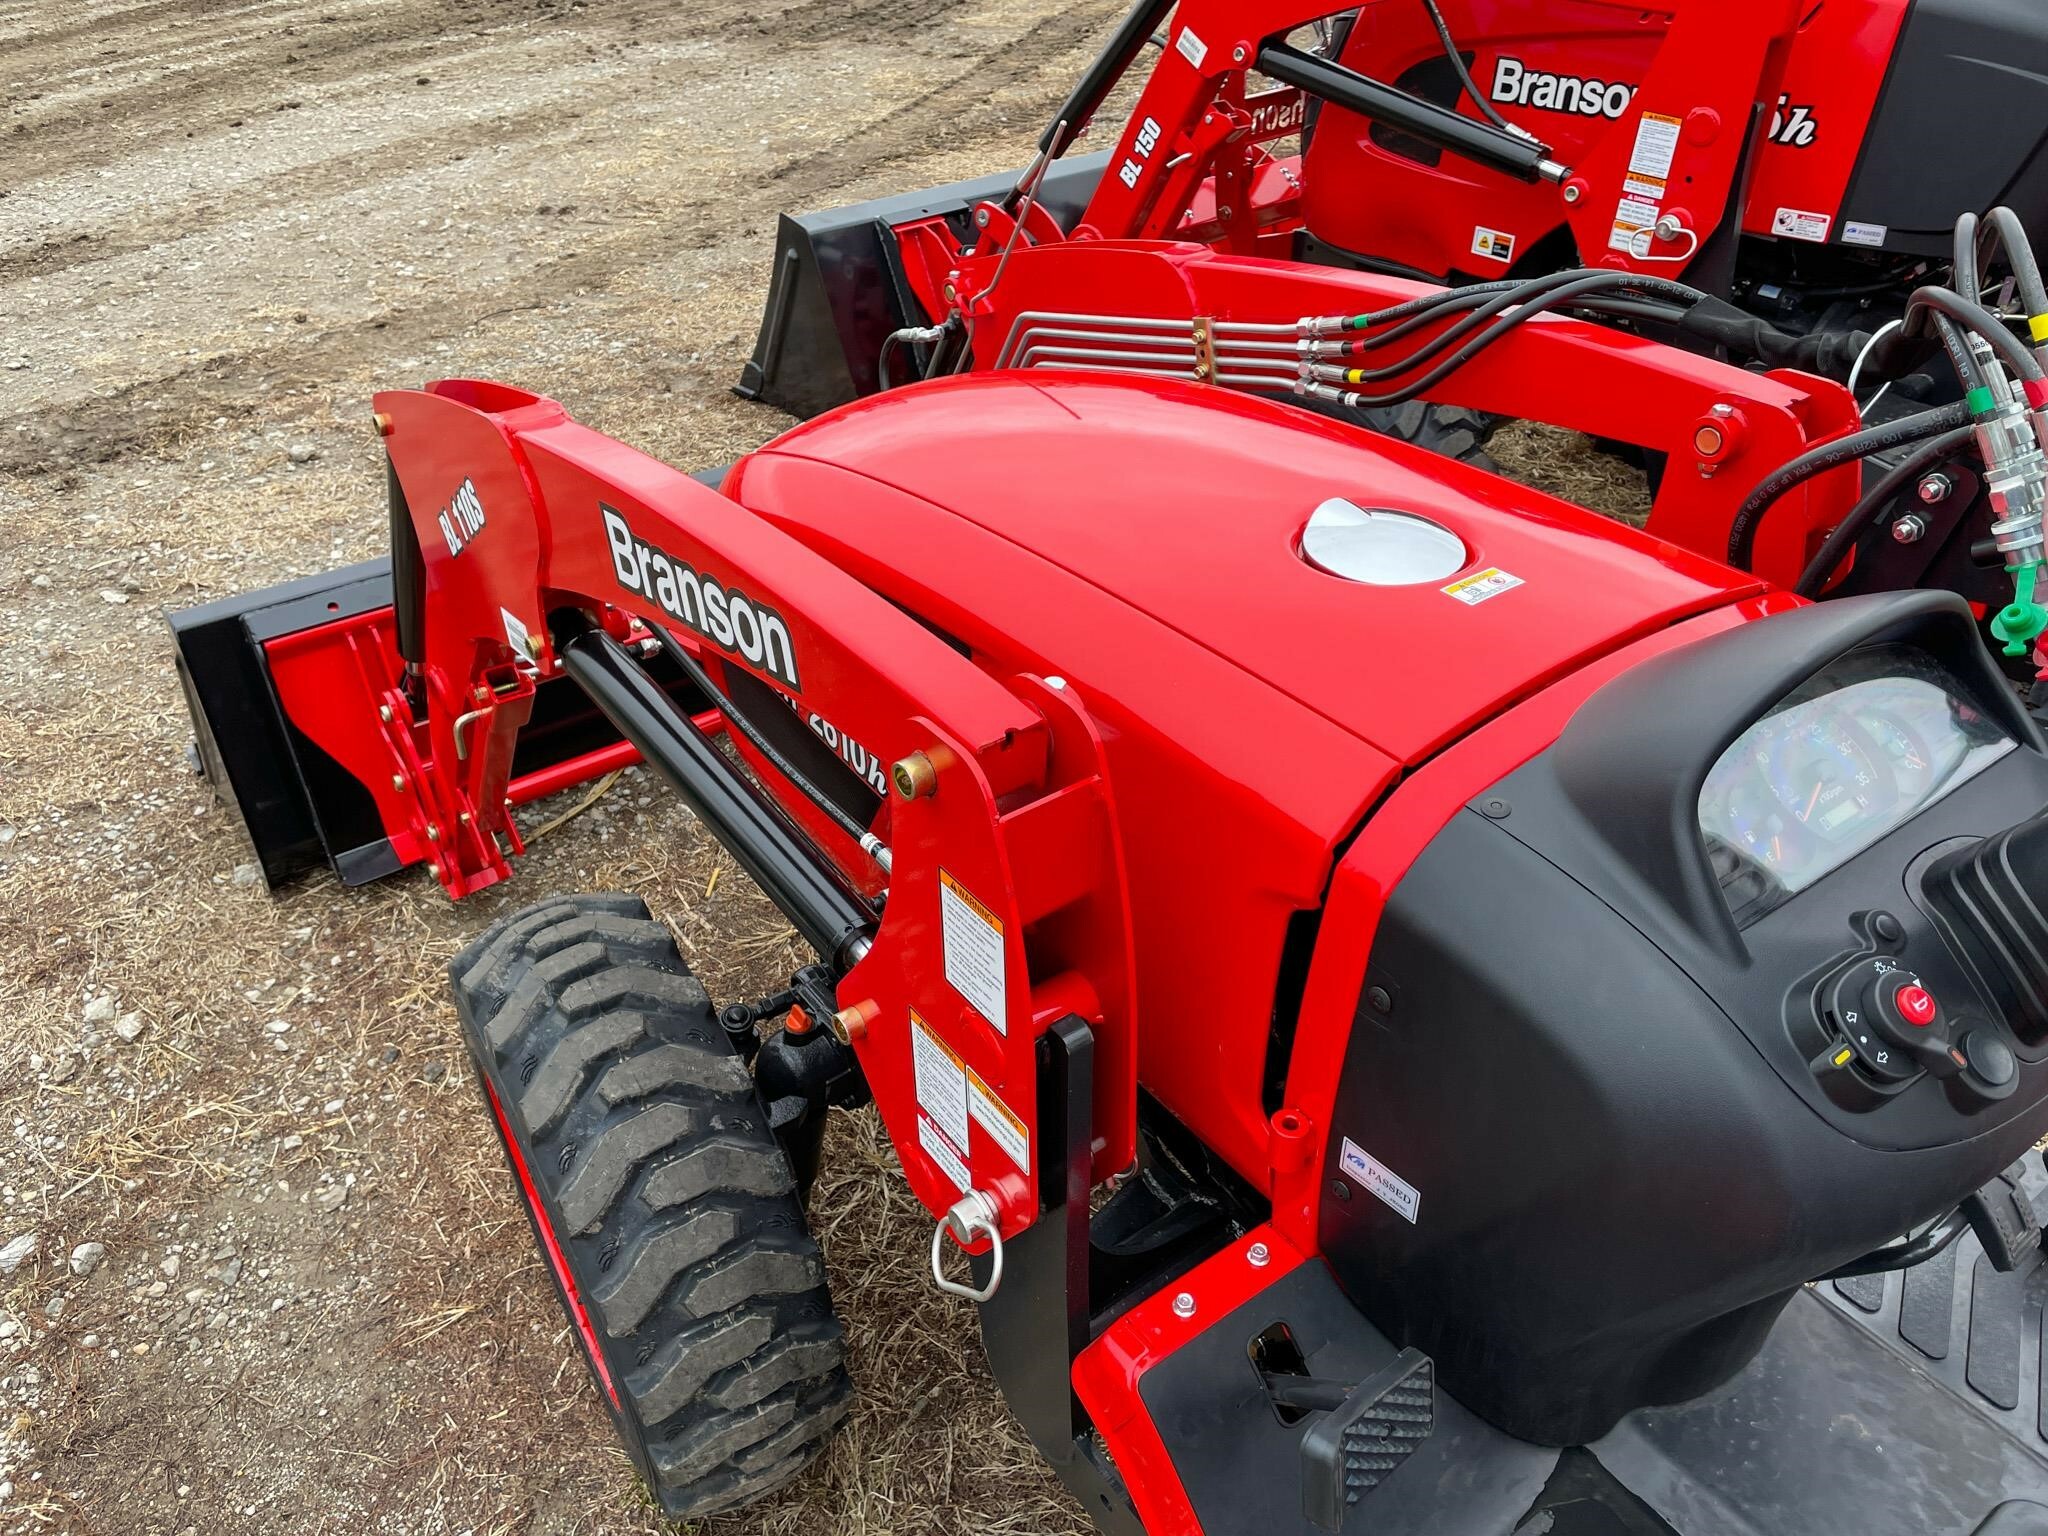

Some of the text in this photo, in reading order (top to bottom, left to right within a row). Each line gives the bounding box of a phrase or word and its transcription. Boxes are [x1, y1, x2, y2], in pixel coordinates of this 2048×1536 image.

[1492, 58, 1638, 118] Branso
[1119, 117, 1161, 189] BL 150
[439, 479, 485, 556] BL 110S
[603, 509, 797, 685] Branson
[1855, 771, 1870, 786] 35
[958, 886, 994, 925] WARNING
[933, 1122, 962, 1160] DANGER
[1368, 1167, 1412, 1205] PASSED
